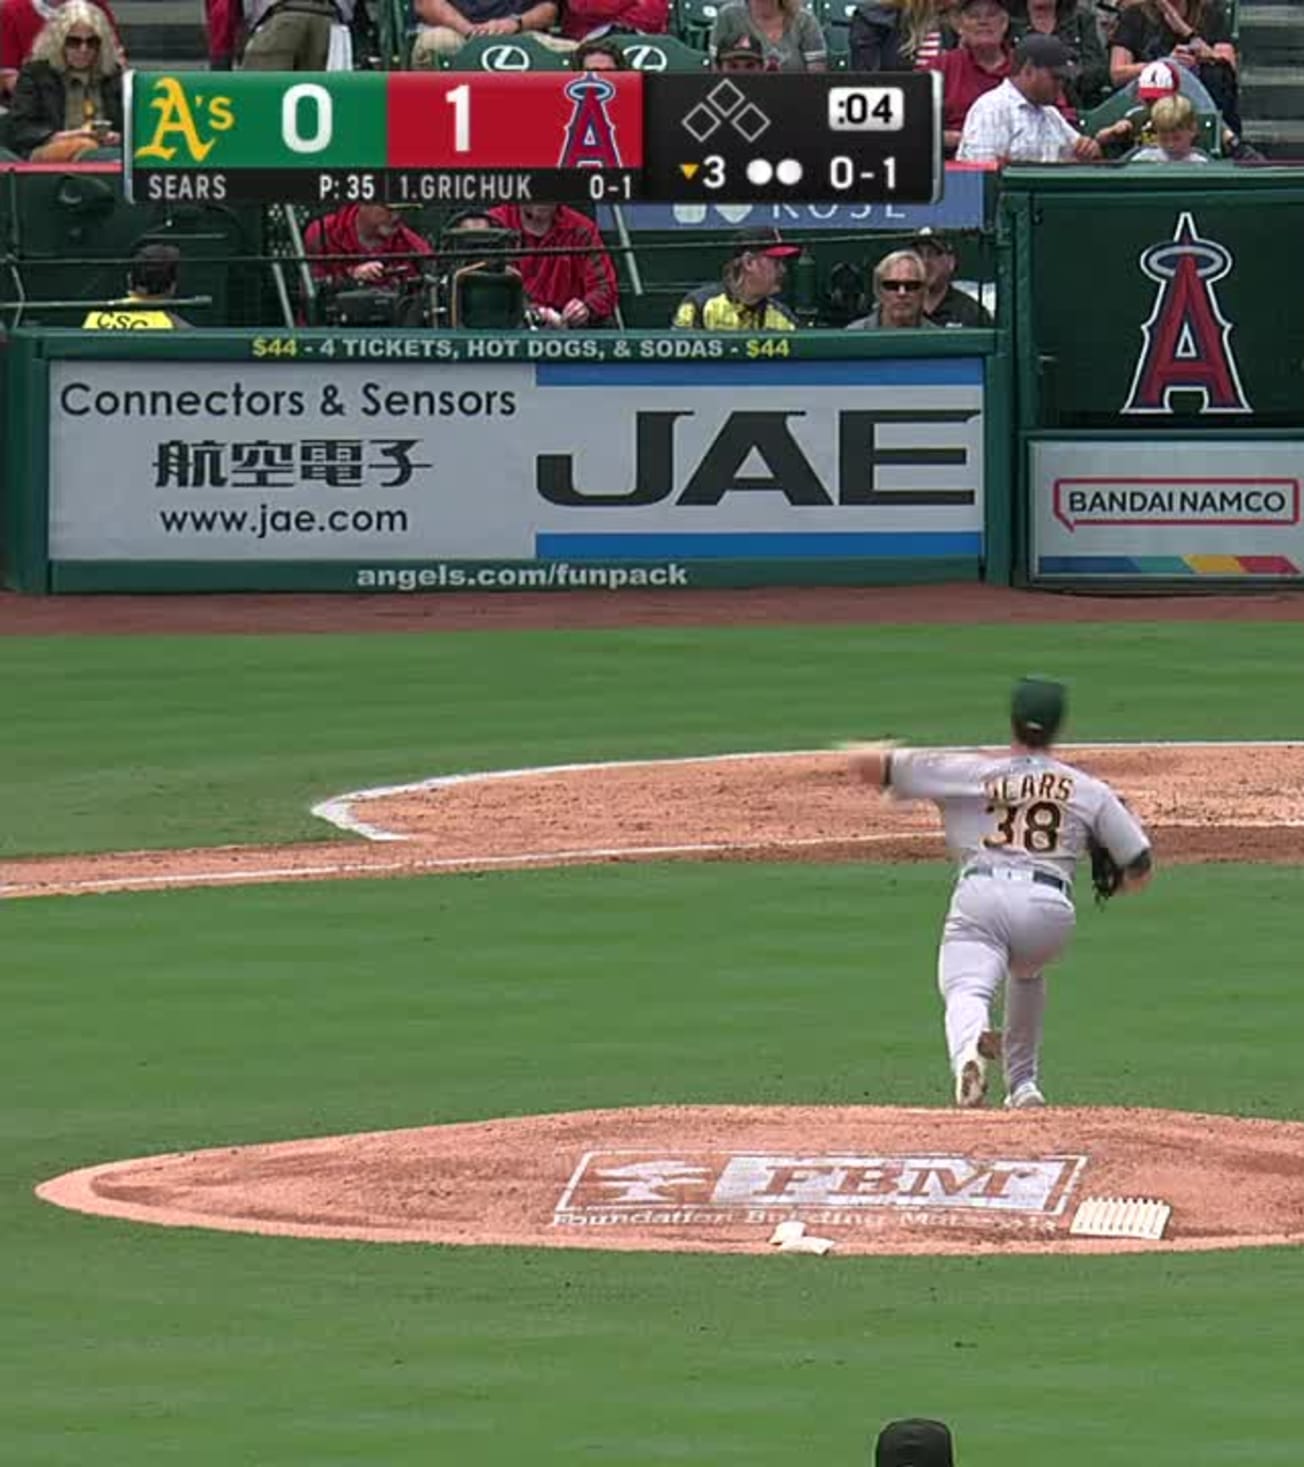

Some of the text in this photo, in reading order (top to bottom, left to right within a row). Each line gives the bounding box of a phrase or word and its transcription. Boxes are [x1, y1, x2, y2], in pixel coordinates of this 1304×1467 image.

[252, 336, 298, 358] $44
[320, 339, 334, 357] 4
[342, 339, 458, 360] TICKETS,
[467, 340, 519, 358] HOT
[528, 340, 605, 361] DOGS,
[613, 340, 631, 358] &
[640, 340, 723, 358] SODAS
[745, 337, 790, 359] $44
[60, 383, 517, 417] Connectors & Sensors
[152, 438, 432, 488] 航空電子
[536, 409, 981, 506] JAE
[1068, 490, 1286, 514] BANDAI NAMCO
[160, 504, 409, 538] www.jae.com
[357, 564, 688, 590] angels.com/funpack
[981, 800, 1063, 853] 38
[752, 1165, 1015, 1198] FBM
